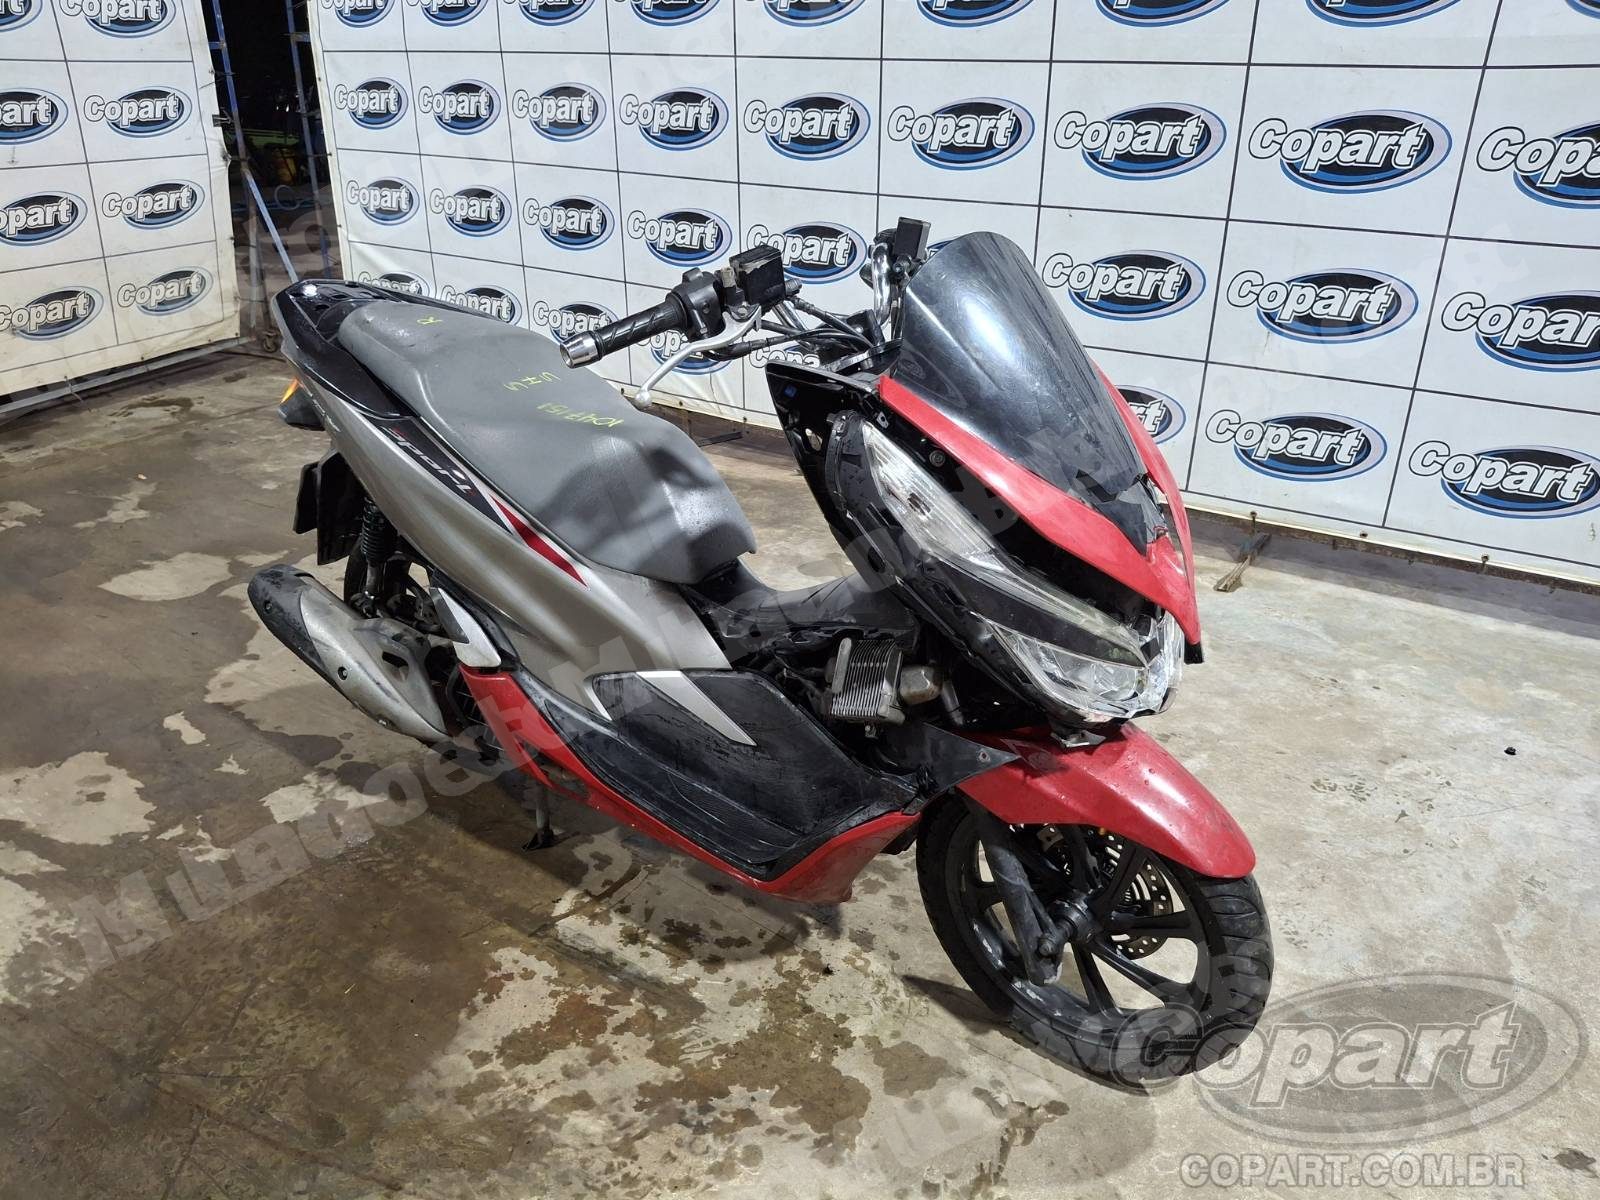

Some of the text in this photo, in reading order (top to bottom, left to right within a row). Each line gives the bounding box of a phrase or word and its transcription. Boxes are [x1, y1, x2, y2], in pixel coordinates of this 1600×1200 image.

[0, 96, 52, 126] art
[84, 94, 179, 127] Copart
[334, 84, 399, 118] Copart
[418, 86, 489, 122] Copart
[513, 89, 594, 126] Copart
[619, 94, 714, 135] Copart
[743, 100, 855, 139] Copart
[887, 106, 1016, 153] Copart
[1054, 111, 1204, 161] Copart
[1249, 118, 1426, 172] Copart
[1477, 126, 1600, 186] Cop
[102, 184, 193, 221] Copart
[346, 180, 409, 213] Copart
[429, 189, 501, 223] Copart
[0, 197, 72, 236] part
[523, 199, 602, 236] Copart
[627, 210, 718, 251] Copart
[117, 270, 201, 308] Copart
[1042, 253, 1186, 302] Copart
[1227, 271, 1397, 324] Copart
[1441, 291, 1600, 348] Copar
[1206, 409, 1365, 464] Copart
[1408, 441, 1598, 503] Copart
